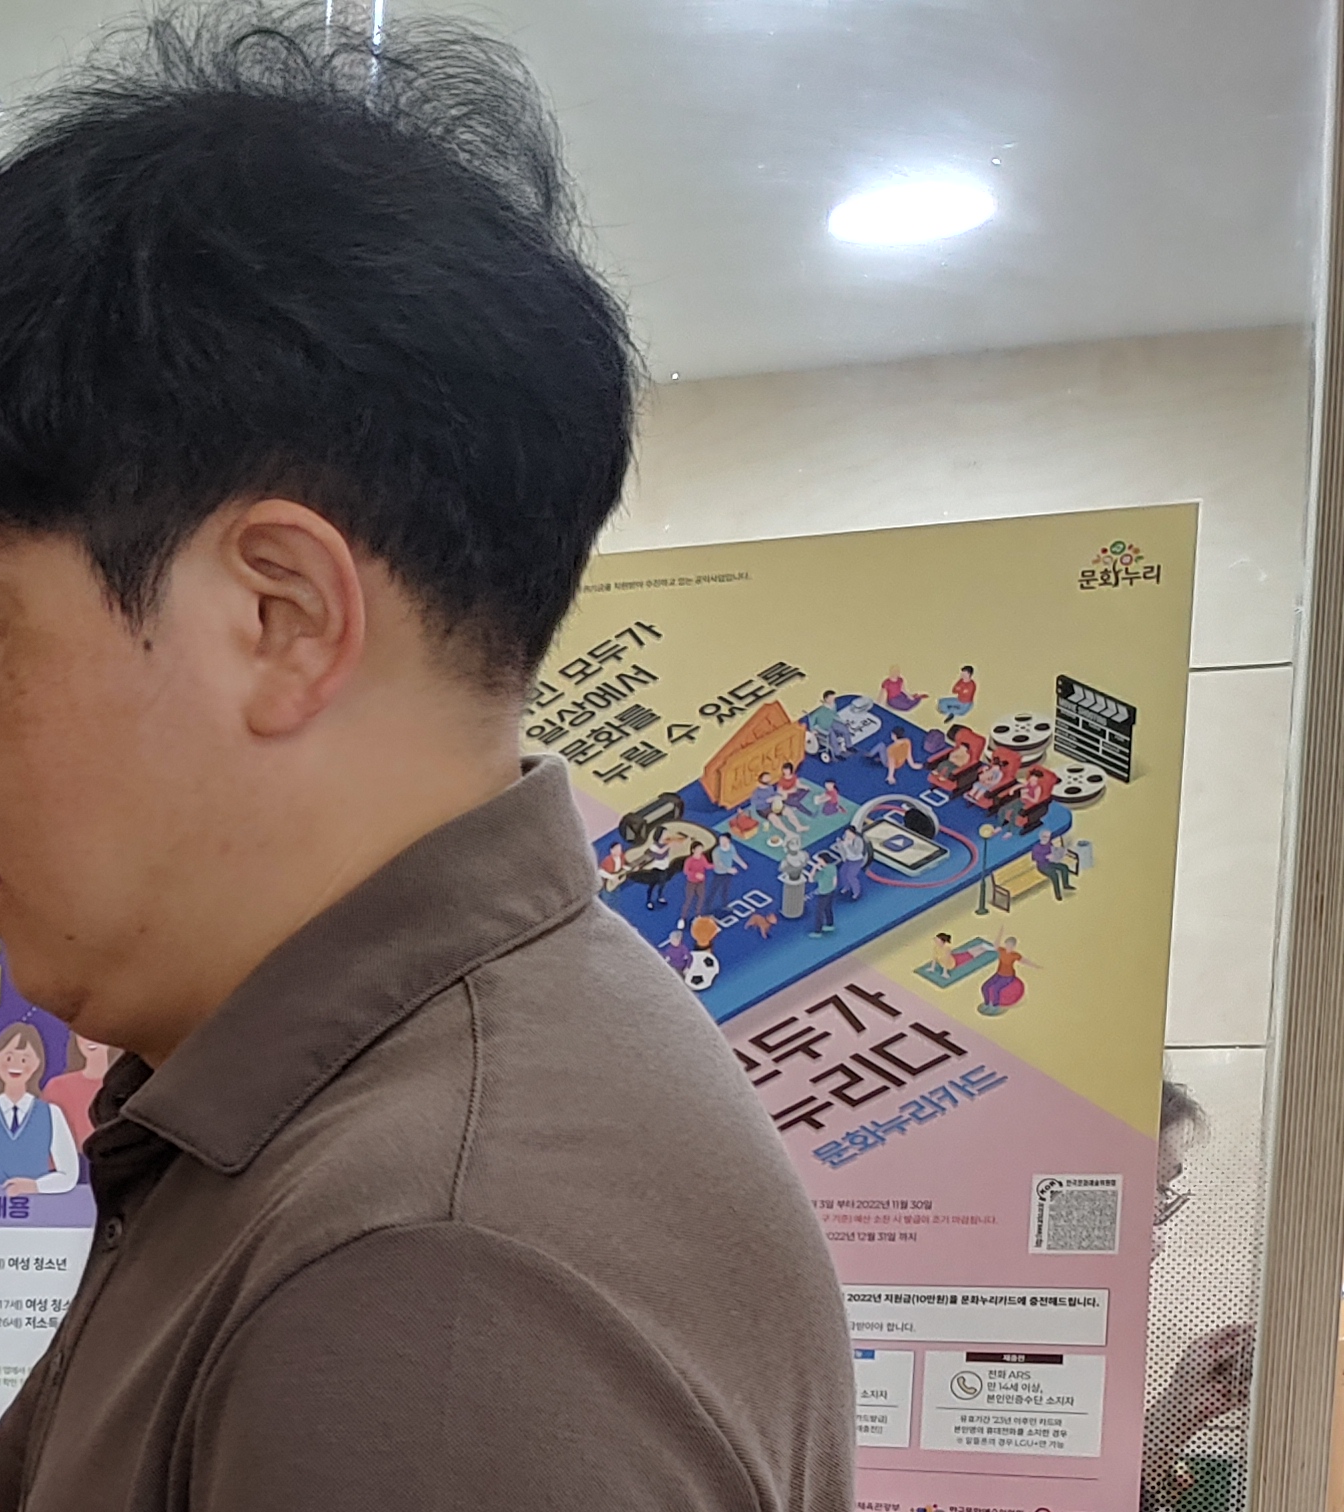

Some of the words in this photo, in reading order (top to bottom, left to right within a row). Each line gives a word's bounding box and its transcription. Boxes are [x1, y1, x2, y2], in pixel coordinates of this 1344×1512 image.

[1078, 565, 1162, 590] 문화누리
[558, 621, 663, 686] 모두가
[525, 664, 660, 746] 일상에서
[558, 704, 661, 766] 문화를
[592, 741, 668, 784] 누릴
[666, 723, 701, 745] 수
[698, 661, 806, 725] 있도록
[733, 983, 904, 1086] 두가
[812, 1065, 1009, 1169] 문화누리카드
[857, 1199, 890, 1210] 2022년
[7, 1257, 31, 1271] 여성
[33, 1258, 68, 1272] 청소년
[25, 1298, 49, 1312] 여성
[847, 1293, 882, 1304] 2022년
[1008, 1370, 1031, 1380] ARS
[1046, 1395, 1075, 1407] 소지자
